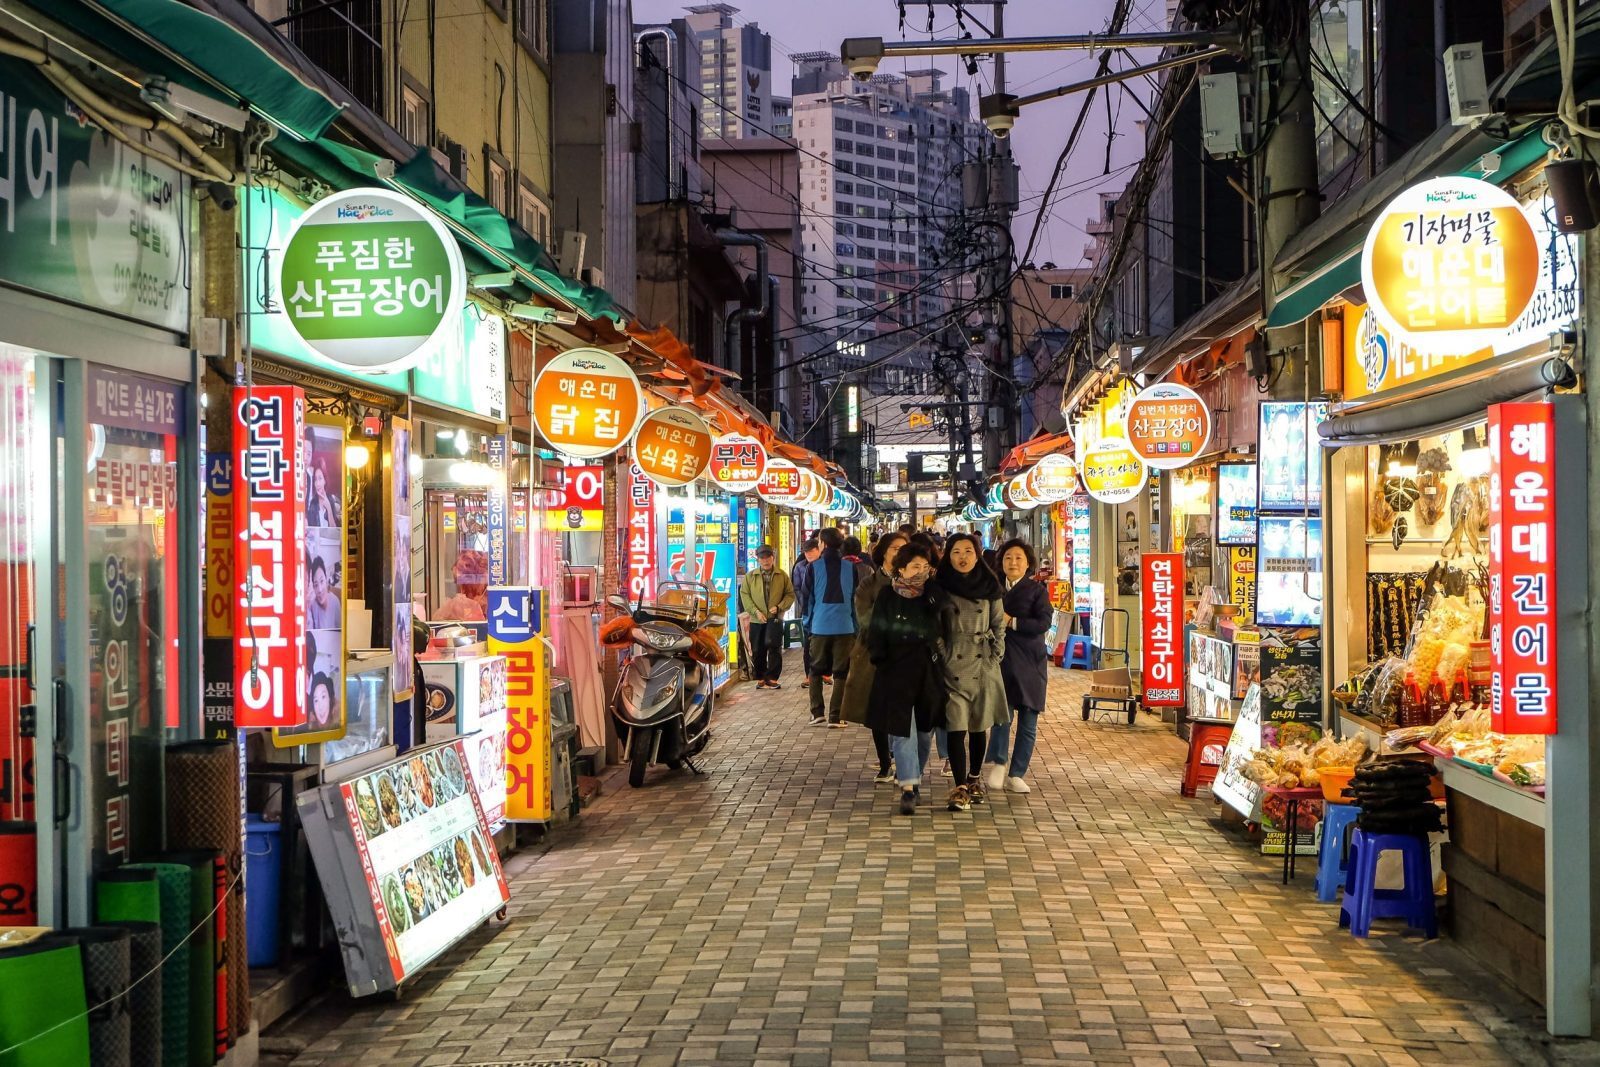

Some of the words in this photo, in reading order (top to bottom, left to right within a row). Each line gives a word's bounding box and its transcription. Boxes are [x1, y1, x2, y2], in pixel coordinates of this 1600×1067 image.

[315, 237, 416, 271] 푸짐한
[289, 275, 443, 318] 산곰장어
[559, 378, 617, 400] 해운대
[1138, 404, 1166, 416] 일번지
[1169, 403, 1197, 415] 자갈치
[656, 424, 697, 447] 해운대
[1133, 416, 1203, 438] 산곰장어
[641, 443, 700, 477] 식육점
[716, 445, 759, 467] 부산
[1146, 688, 1180, 701] 원조집
